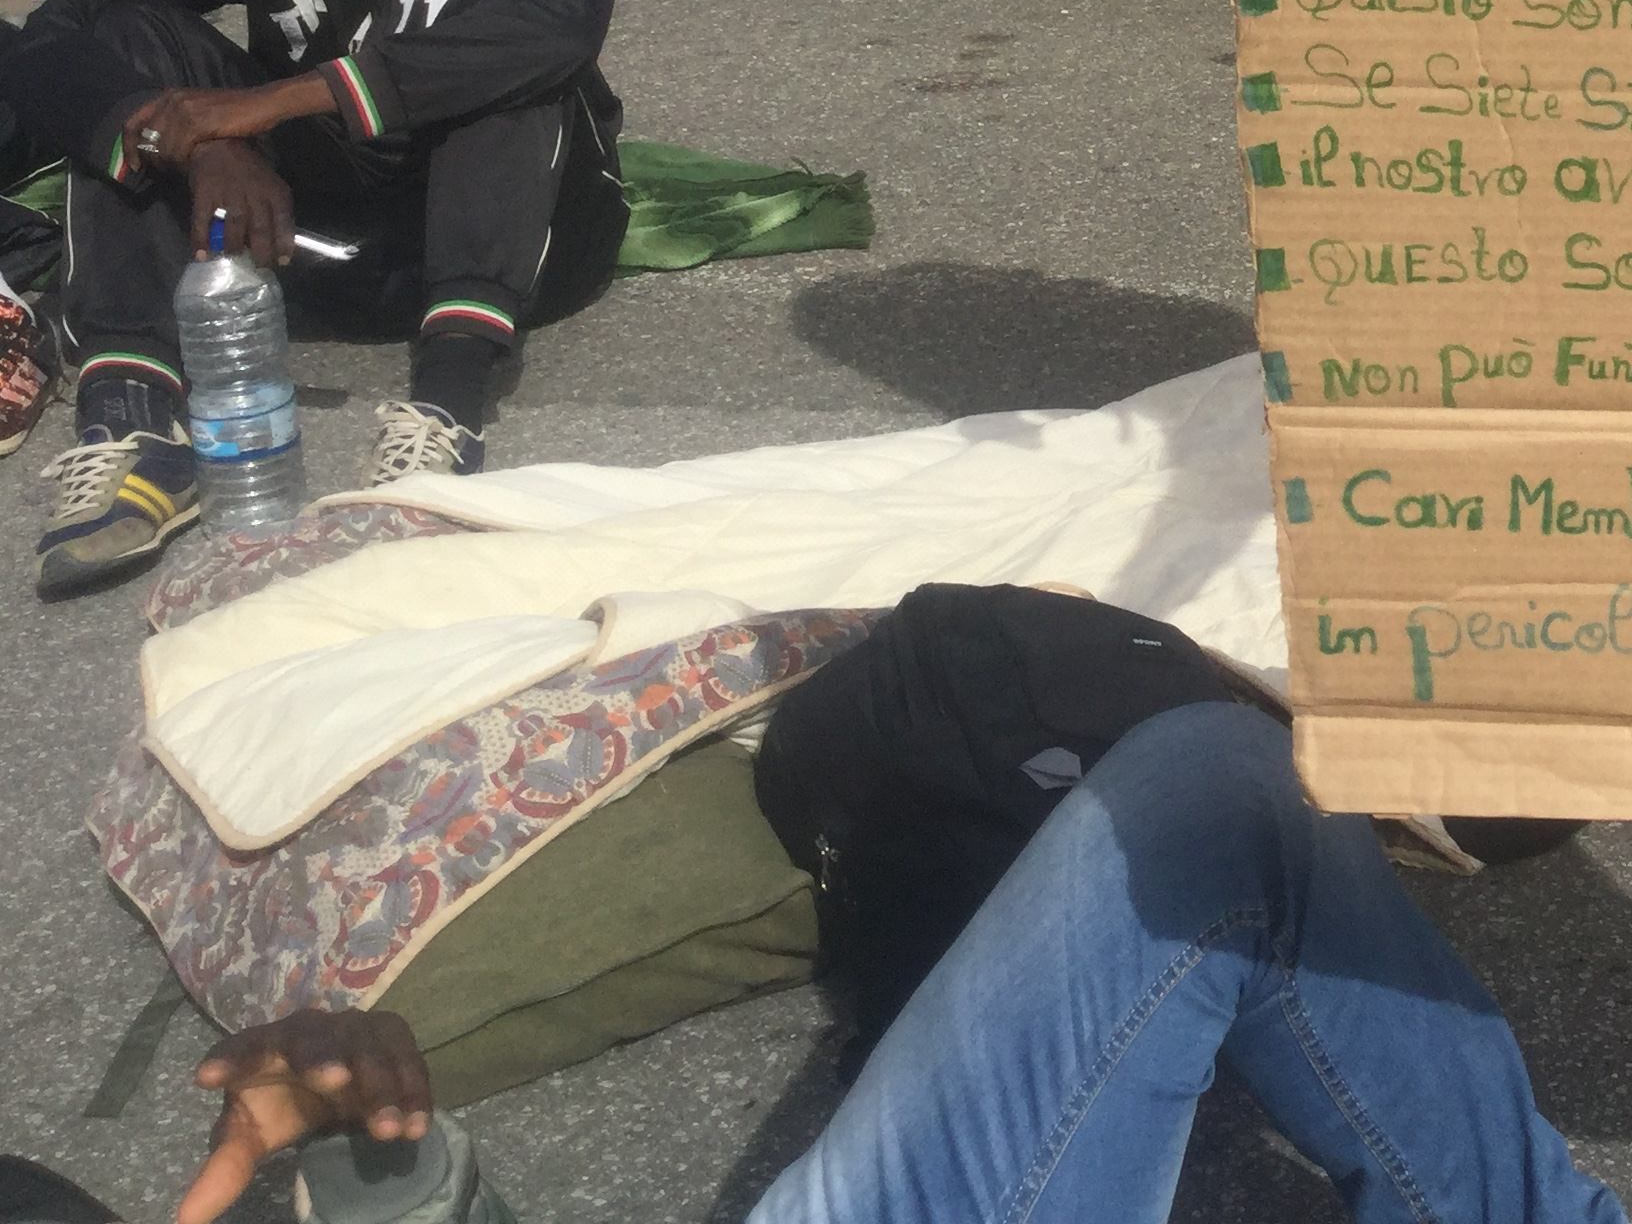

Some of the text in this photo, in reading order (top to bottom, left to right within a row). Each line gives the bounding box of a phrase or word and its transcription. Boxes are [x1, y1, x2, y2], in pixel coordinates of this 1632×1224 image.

[1290, 43, 1398, 110] Se
[1299, 124, 1340, 189] il
[1350, 138, 1528, 198] nostro
[1318, 357, 1419, 403] Non
[1341, 468, 1485, 532] Cari
